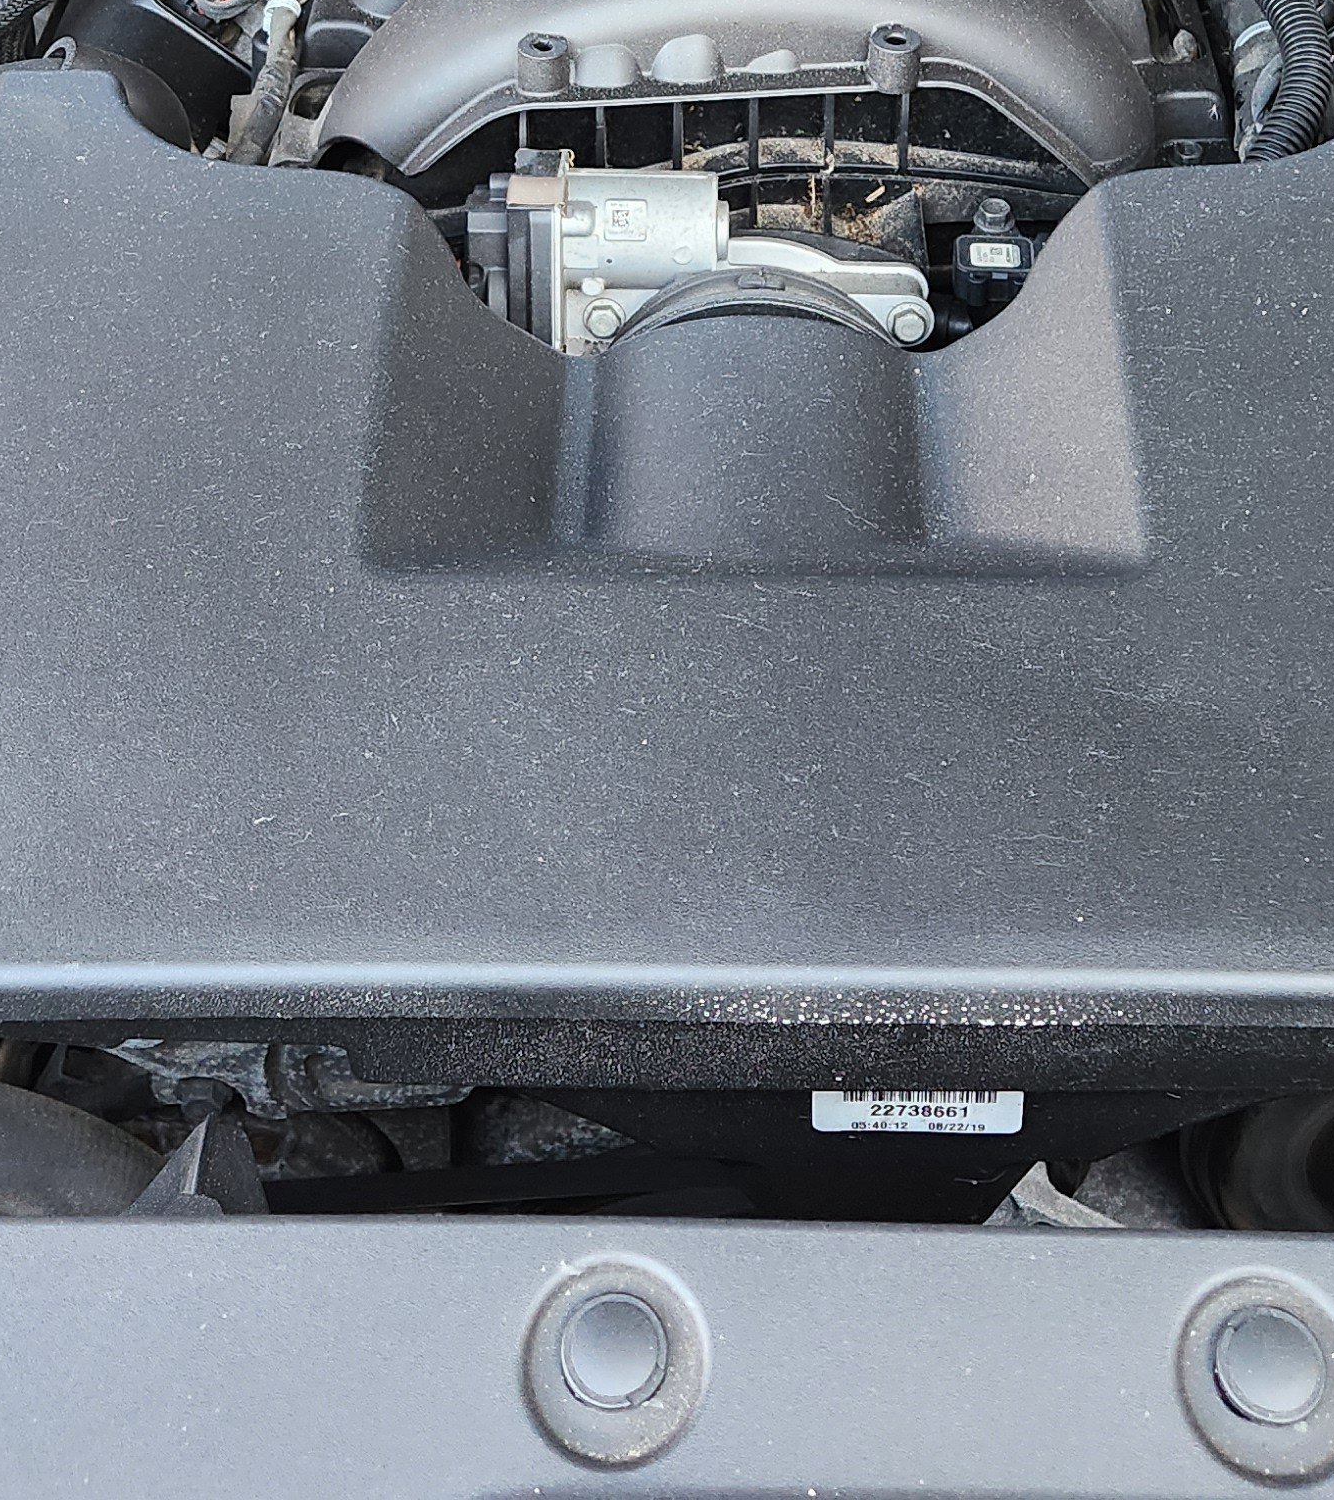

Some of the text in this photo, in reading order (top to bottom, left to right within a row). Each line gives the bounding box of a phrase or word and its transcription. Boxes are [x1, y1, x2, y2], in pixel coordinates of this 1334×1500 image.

[869, 1103, 970, 1119] 22738661
[850, 1120, 987, 1132] 05:40:12 08/22/19
